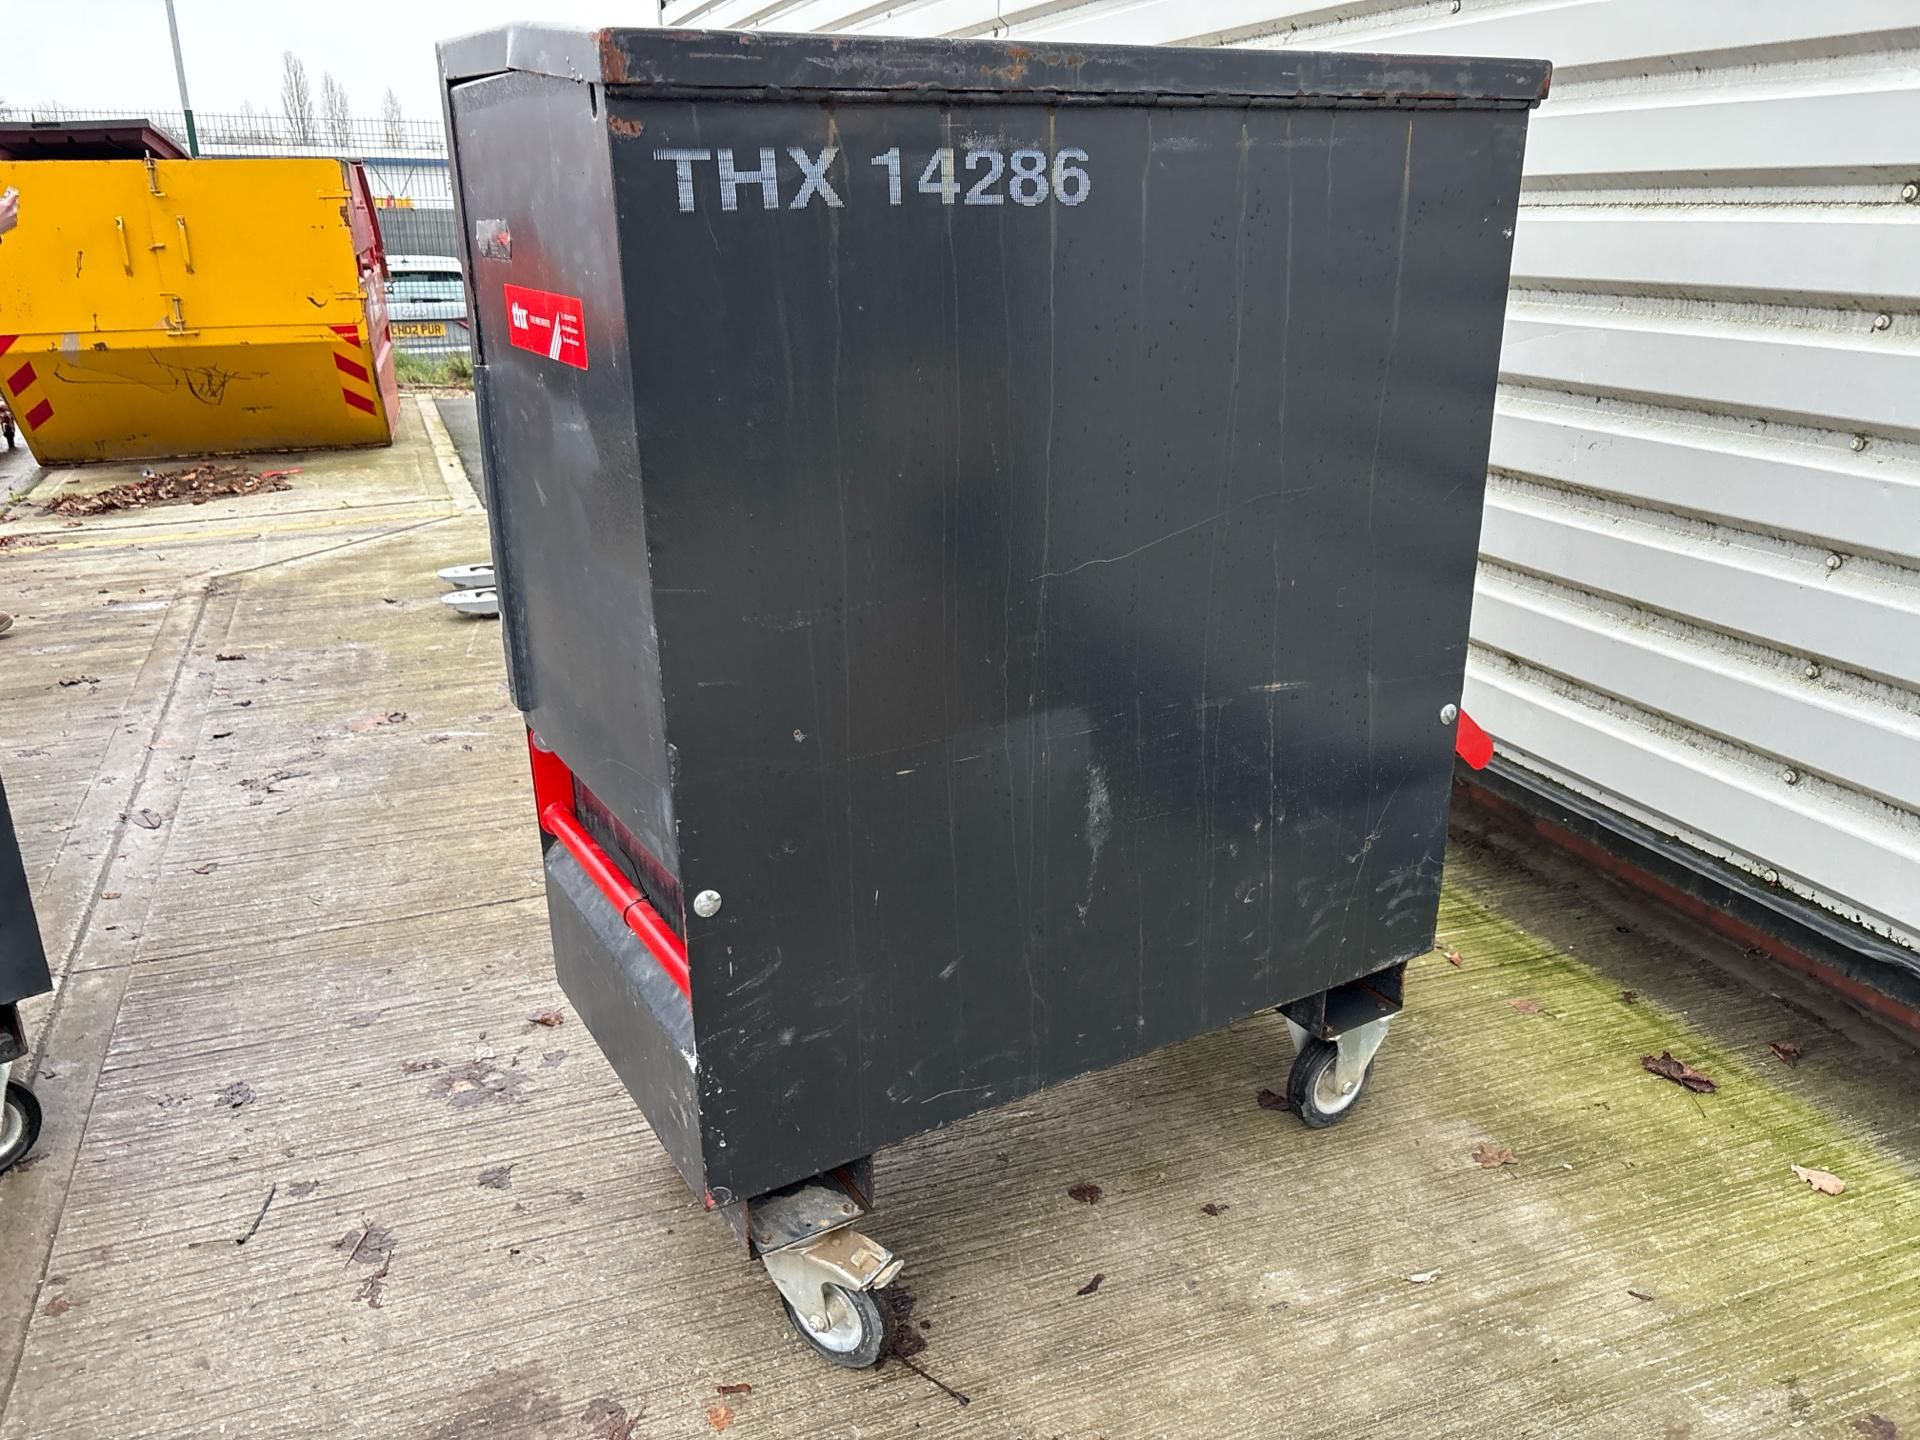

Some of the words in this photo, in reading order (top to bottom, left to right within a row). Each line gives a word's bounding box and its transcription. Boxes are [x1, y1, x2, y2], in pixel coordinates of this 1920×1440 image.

[653, 146, 846, 212] THX
[871, 147, 1091, 207] 14286
[421, 323, 441, 336] PUR
